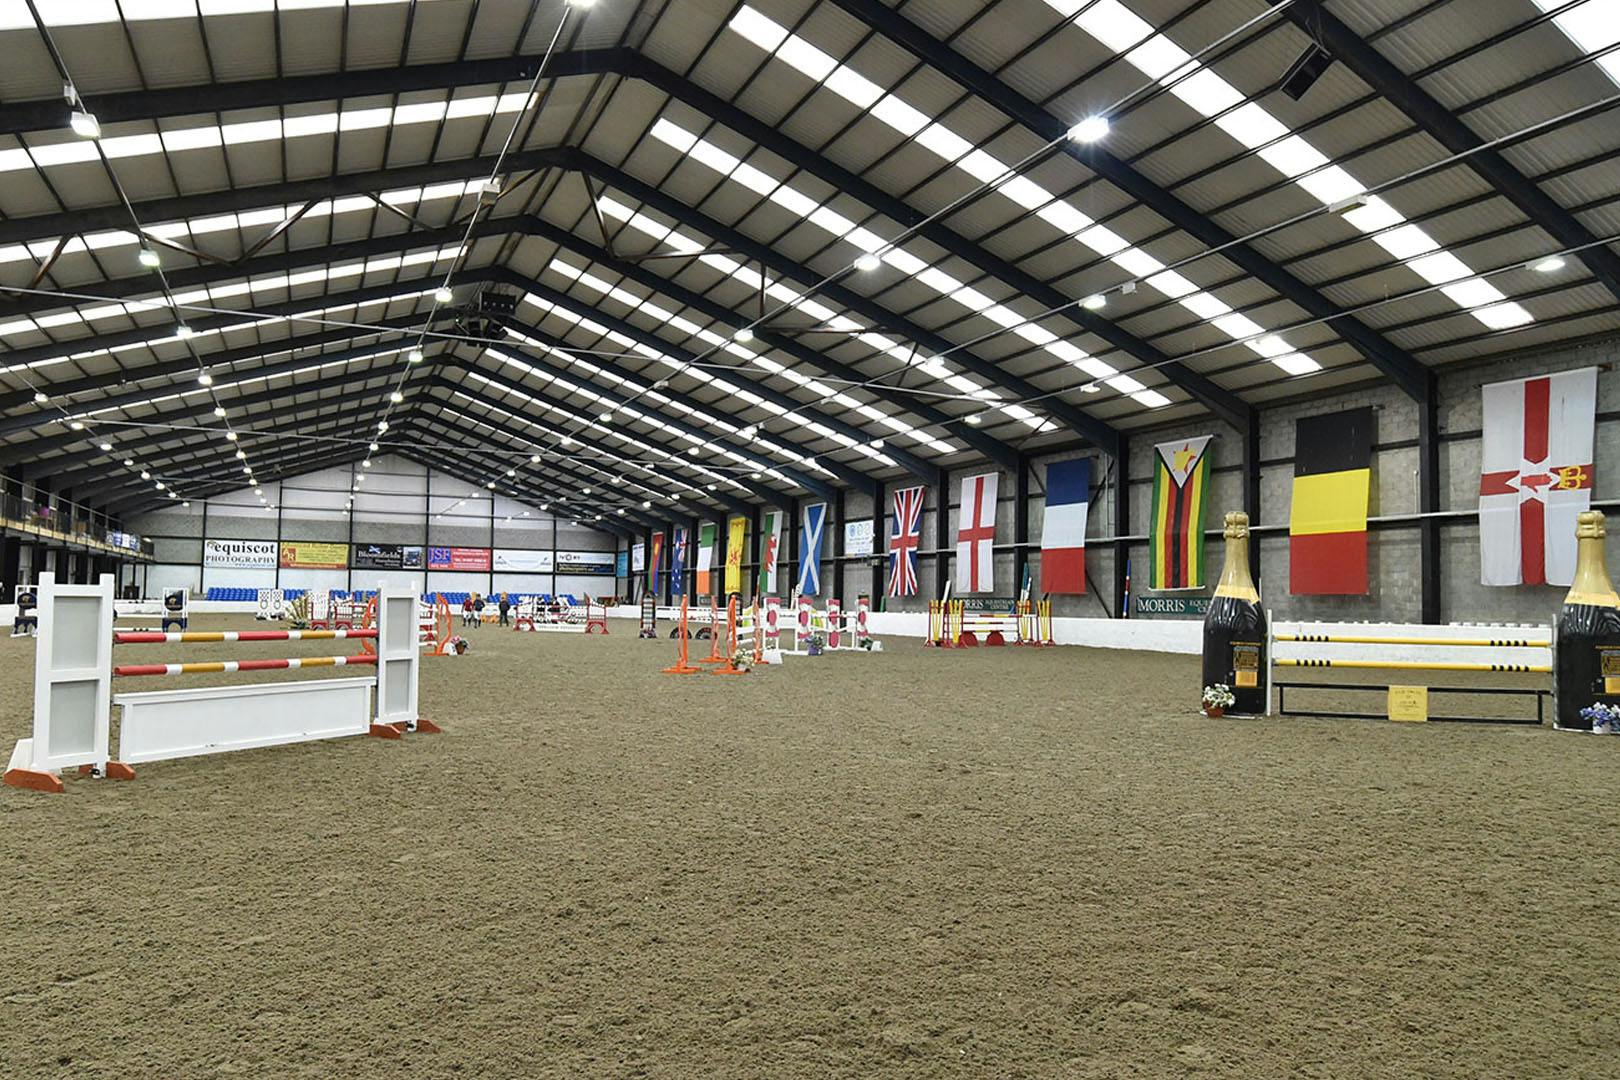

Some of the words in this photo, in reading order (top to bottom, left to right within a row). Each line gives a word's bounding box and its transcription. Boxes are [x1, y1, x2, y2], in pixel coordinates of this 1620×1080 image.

[214, 541, 275, 555] equiscot
[430, 547, 450, 561] JSF
[205, 555, 275, 564] PHOTOGRAPHY
[1138, 599, 1185, 612] MORRIS
